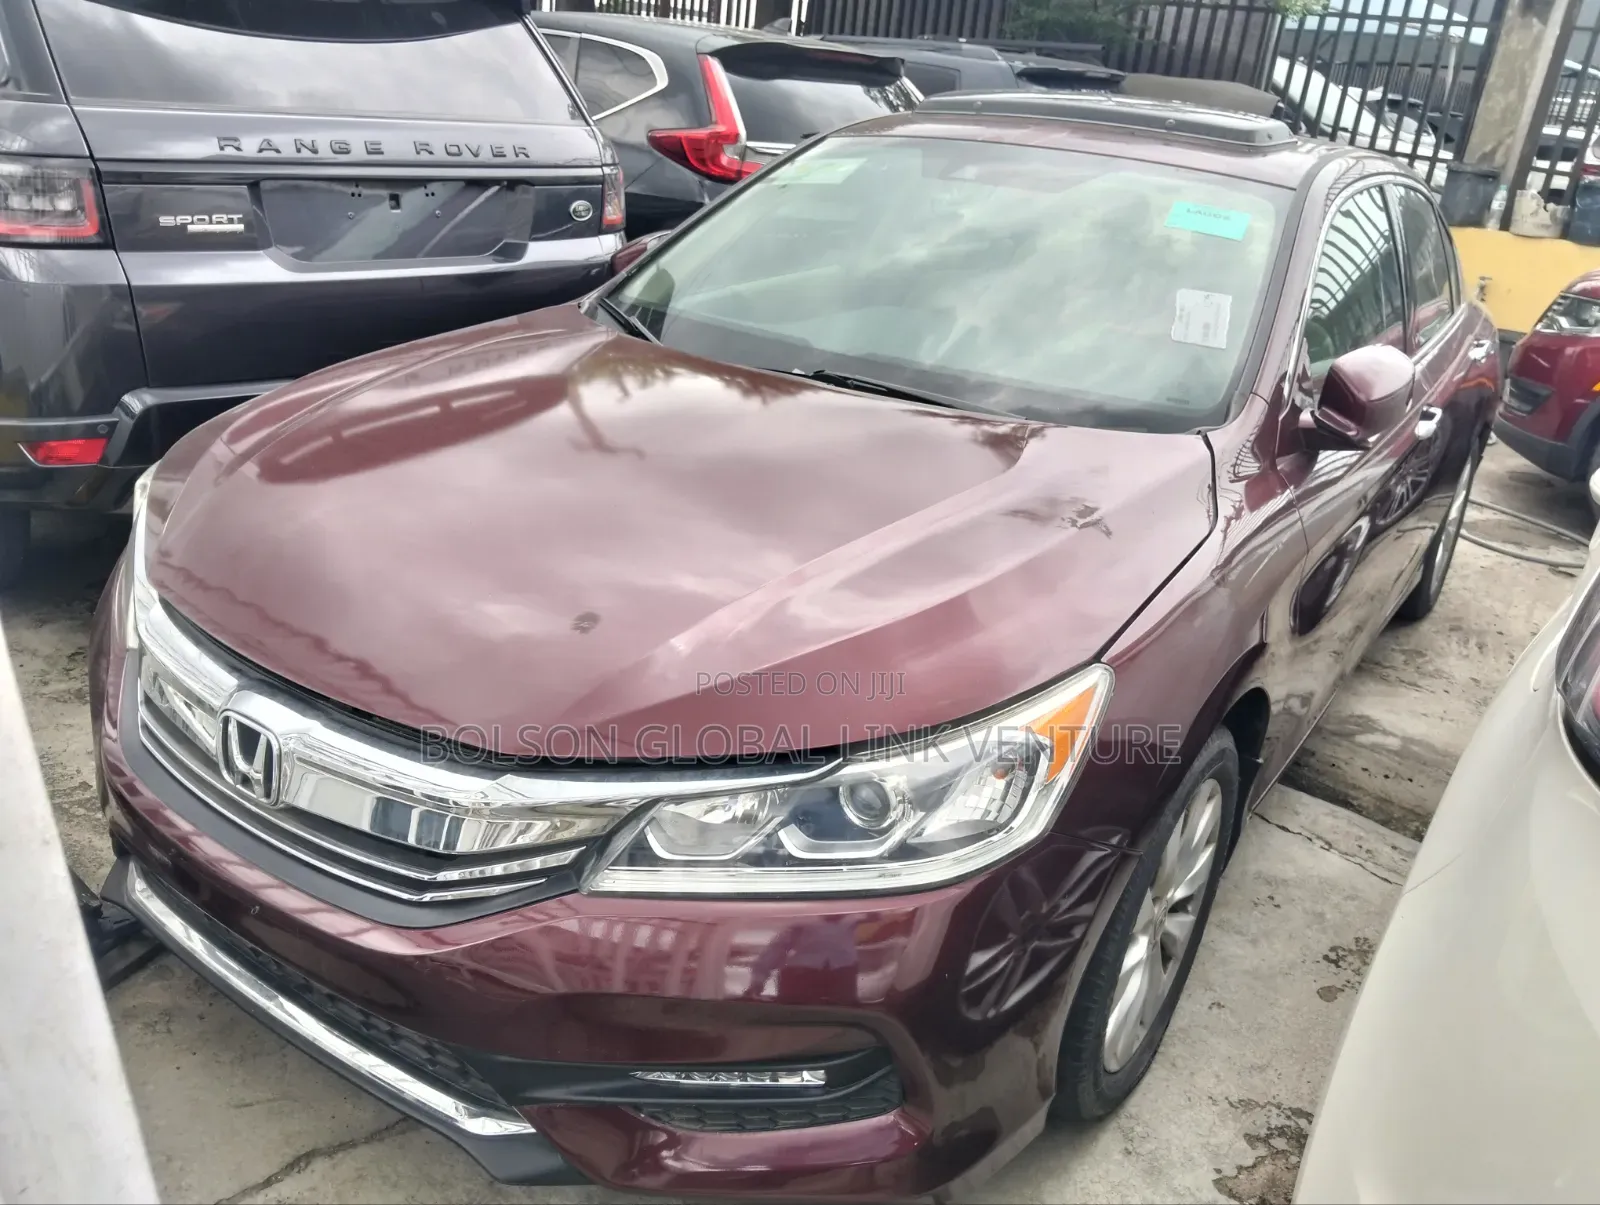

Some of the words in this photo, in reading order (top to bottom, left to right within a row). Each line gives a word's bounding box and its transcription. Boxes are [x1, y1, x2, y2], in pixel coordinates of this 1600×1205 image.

[216, 136, 384, 155] RANGE
[413, 140, 531, 158] ROVER
[159, 213, 243, 227] SPORT
